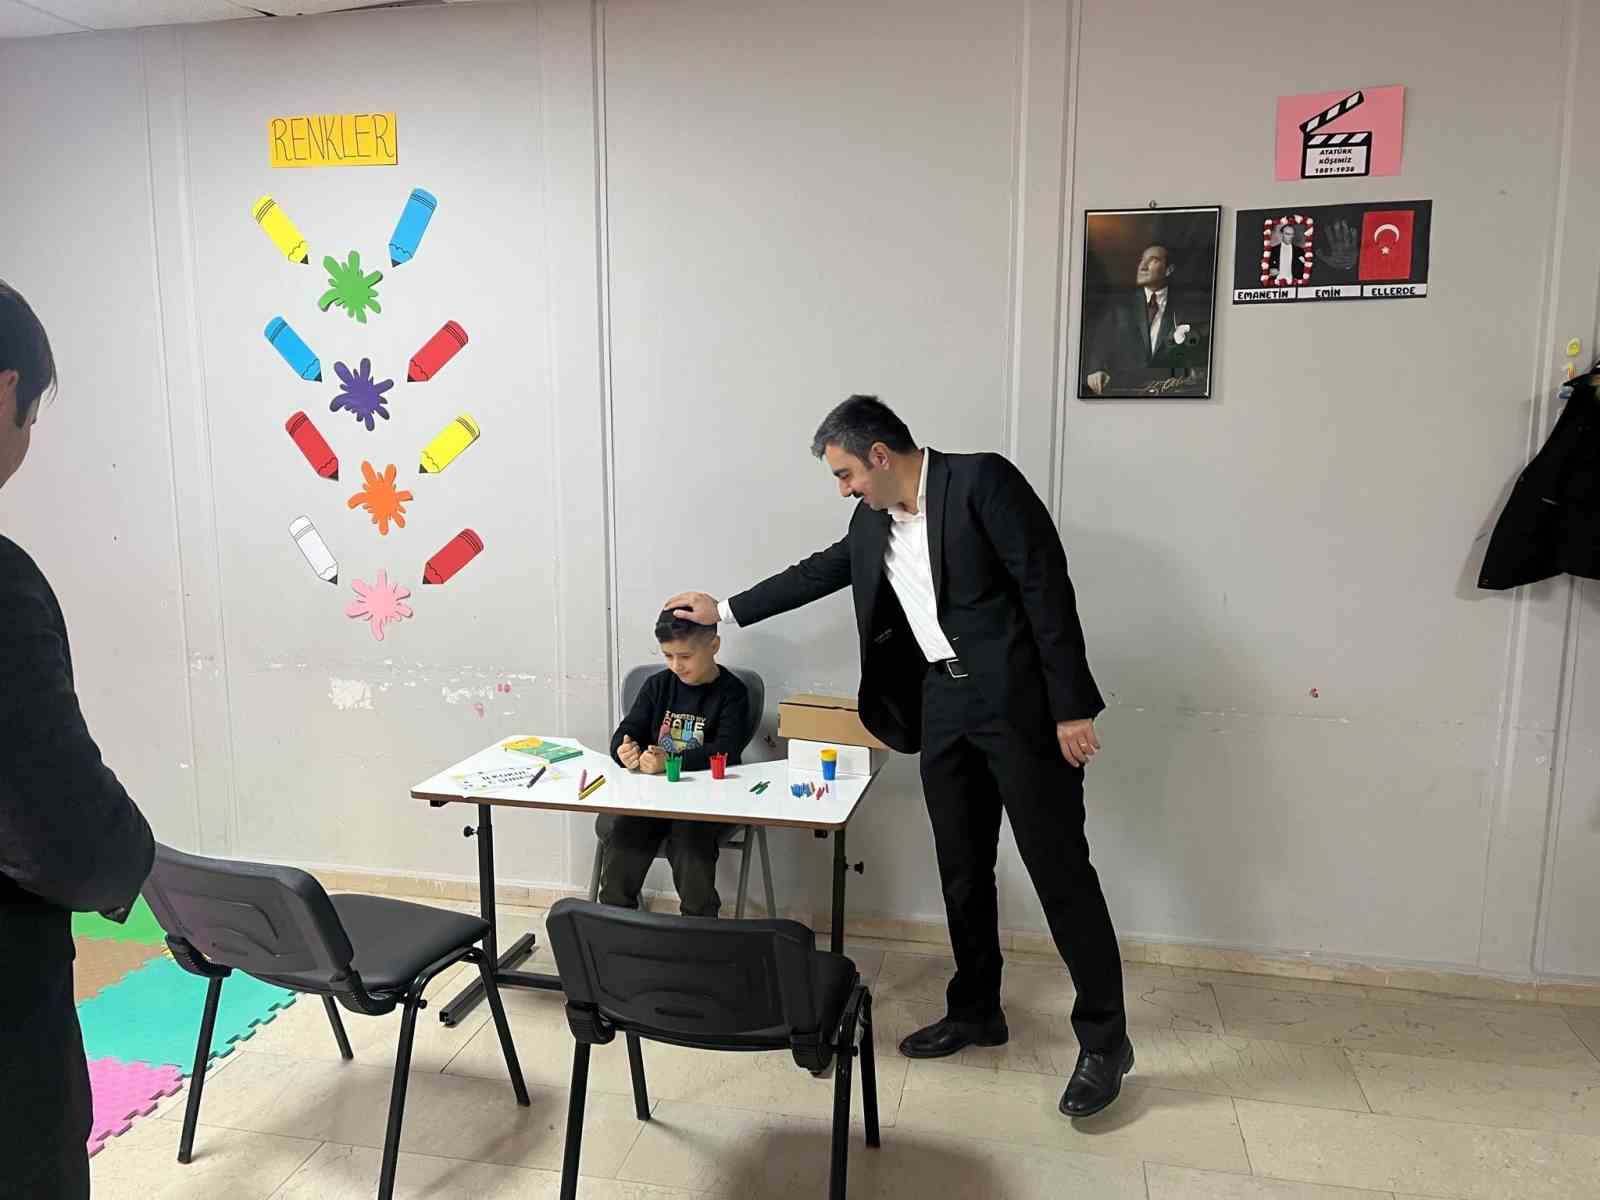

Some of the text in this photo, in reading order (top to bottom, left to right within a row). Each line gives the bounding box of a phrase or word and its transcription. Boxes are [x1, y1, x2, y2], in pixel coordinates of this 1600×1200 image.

[271, 113, 394, 161] RENKLER
[1319, 147, 1353, 155] ATATÜRK
[1318, 155, 1352, 165] KÖŞEMİZ
[1237, 286, 1416, 300] EMANETİN EMİN ELLERDE
